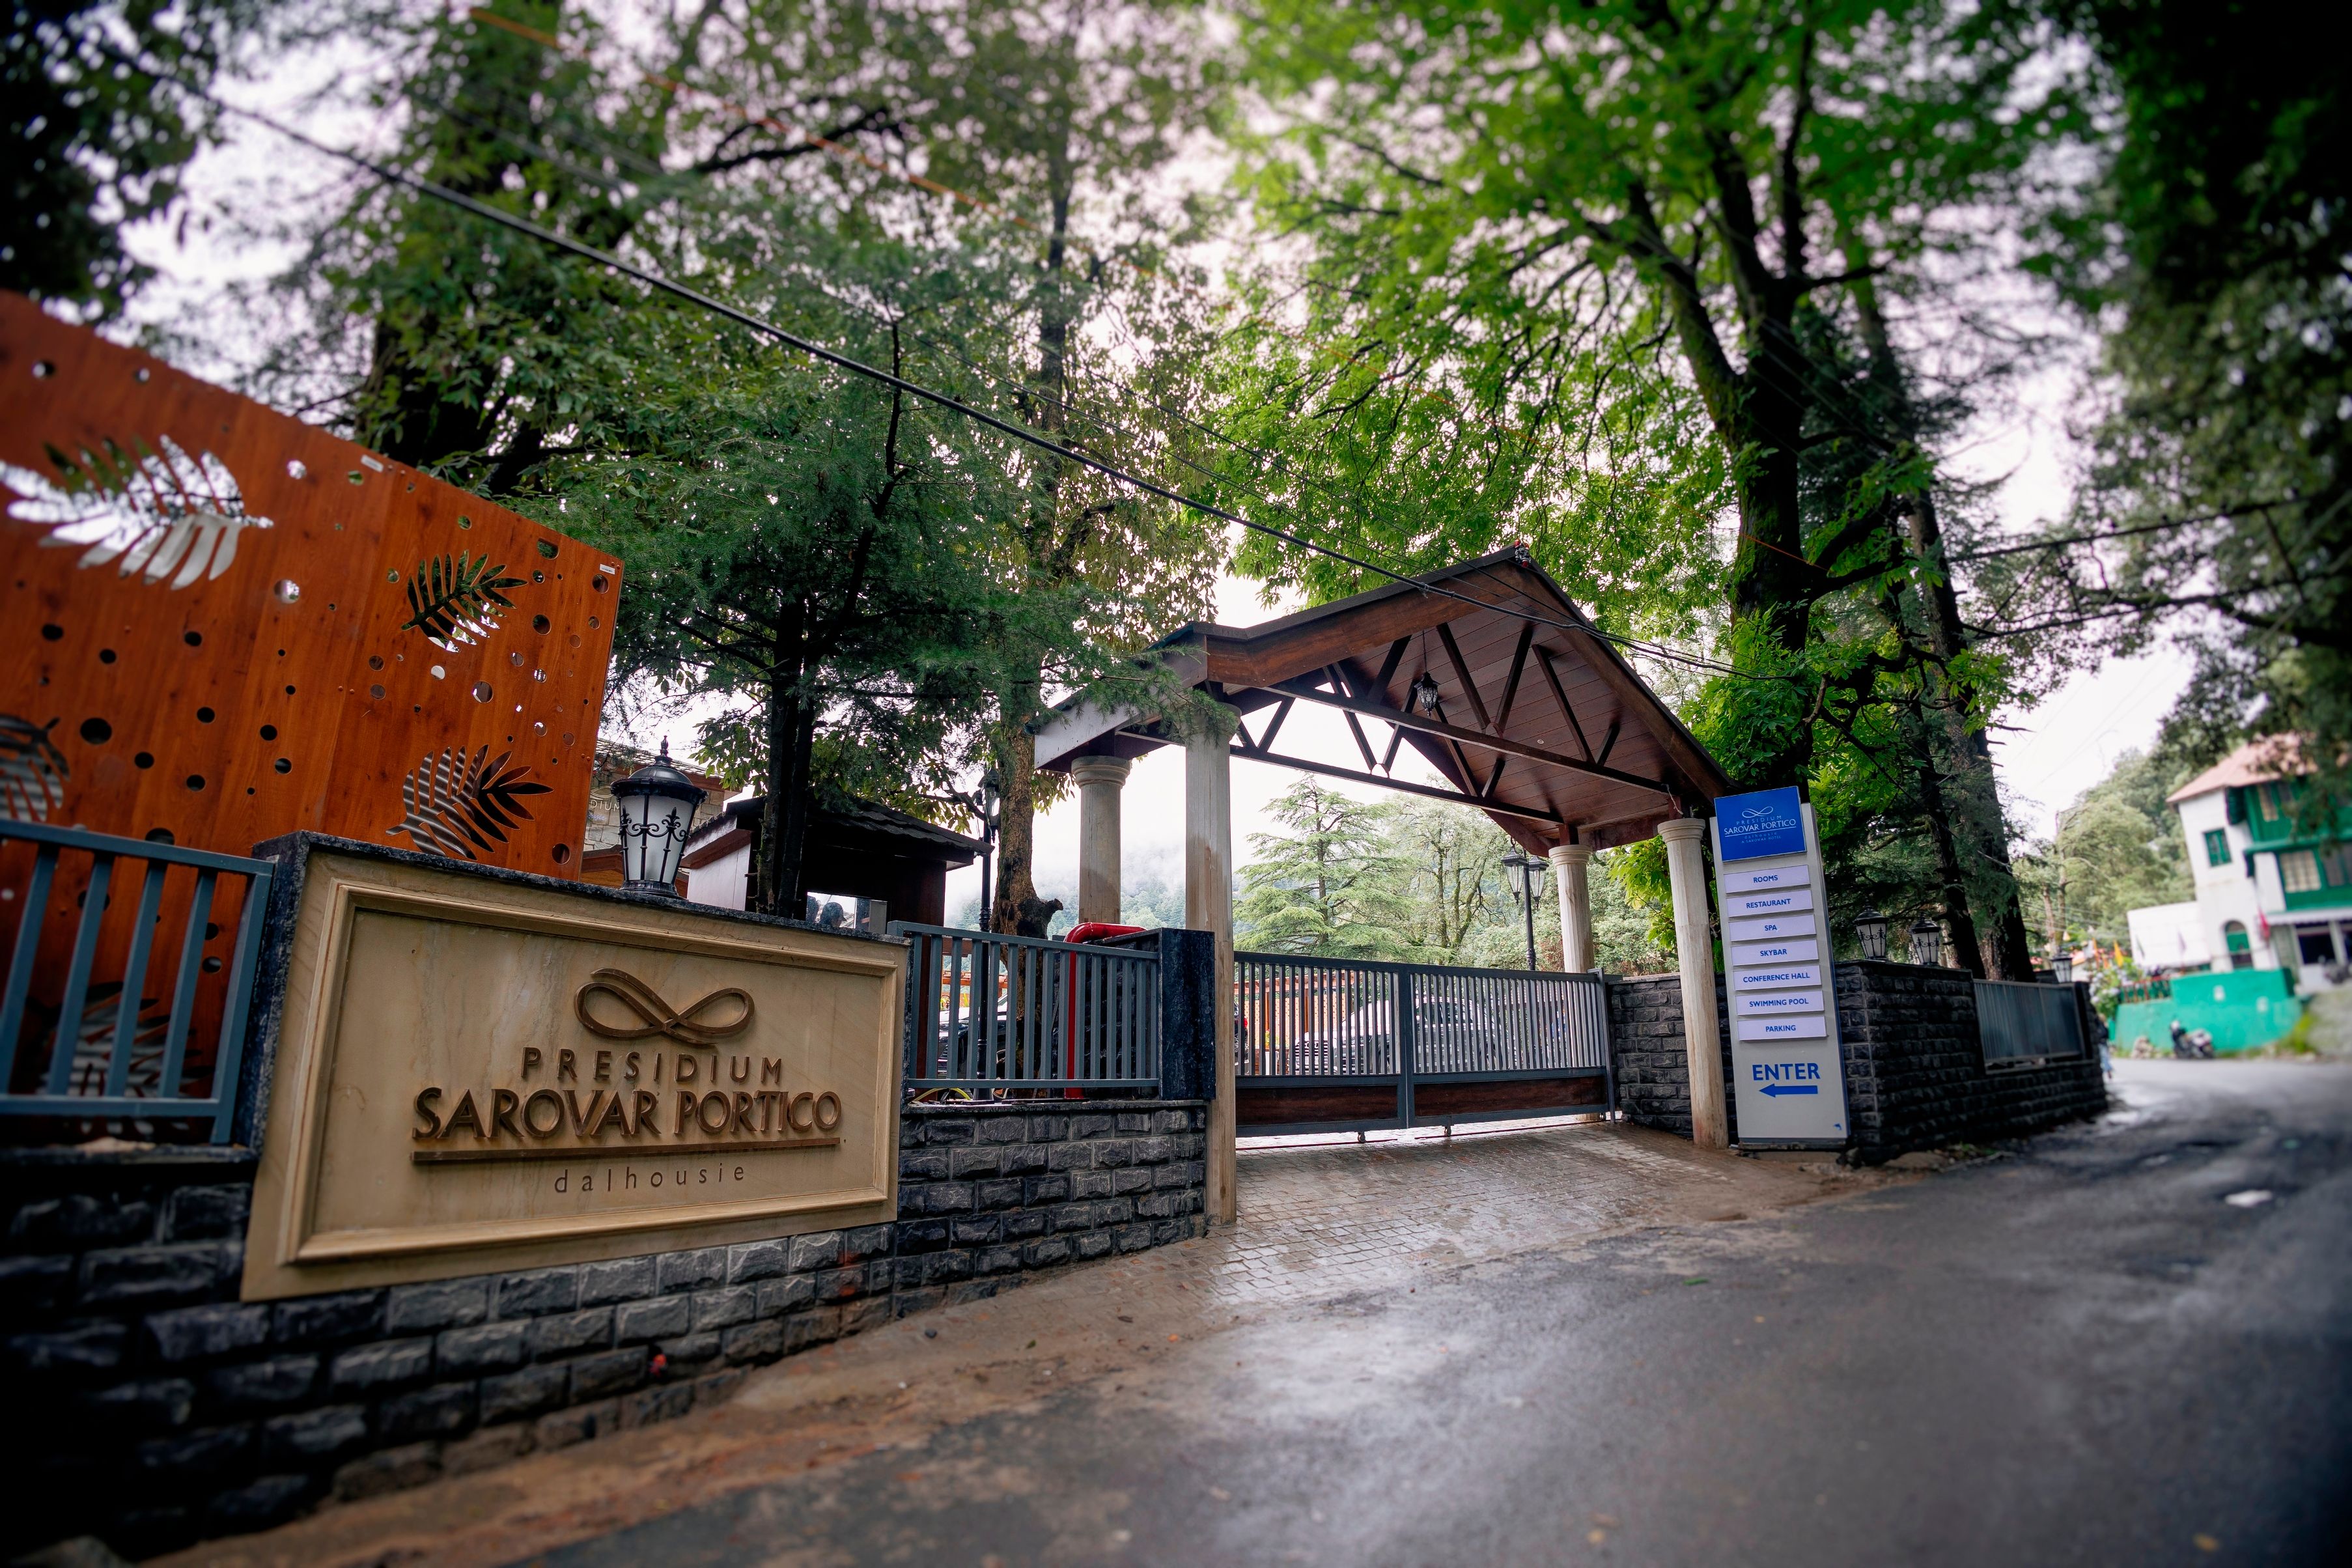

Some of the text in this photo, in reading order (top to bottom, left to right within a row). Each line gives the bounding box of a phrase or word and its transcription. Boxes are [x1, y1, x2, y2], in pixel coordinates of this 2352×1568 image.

[1736, 815, 1782, 825] PRESIDIUM
[1724, 819, 1796, 835] SAROVAR PORTICO
[1753, 875, 1778, 883] ROOMS
[1746, 899, 1791, 908] RESTAURANT
[1743, 973, 1789, 983] CONFERENCE
[1749, 999, 1787, 1007] SWIMMING
[521, 1046, 783, 1084] PRESIDIUM
[1752, 1063, 1821, 1081] ENTER
[412, 1087, 843, 1140] SAROVAR PORTICO
[554, 1164, 745, 1194] dalhousie
